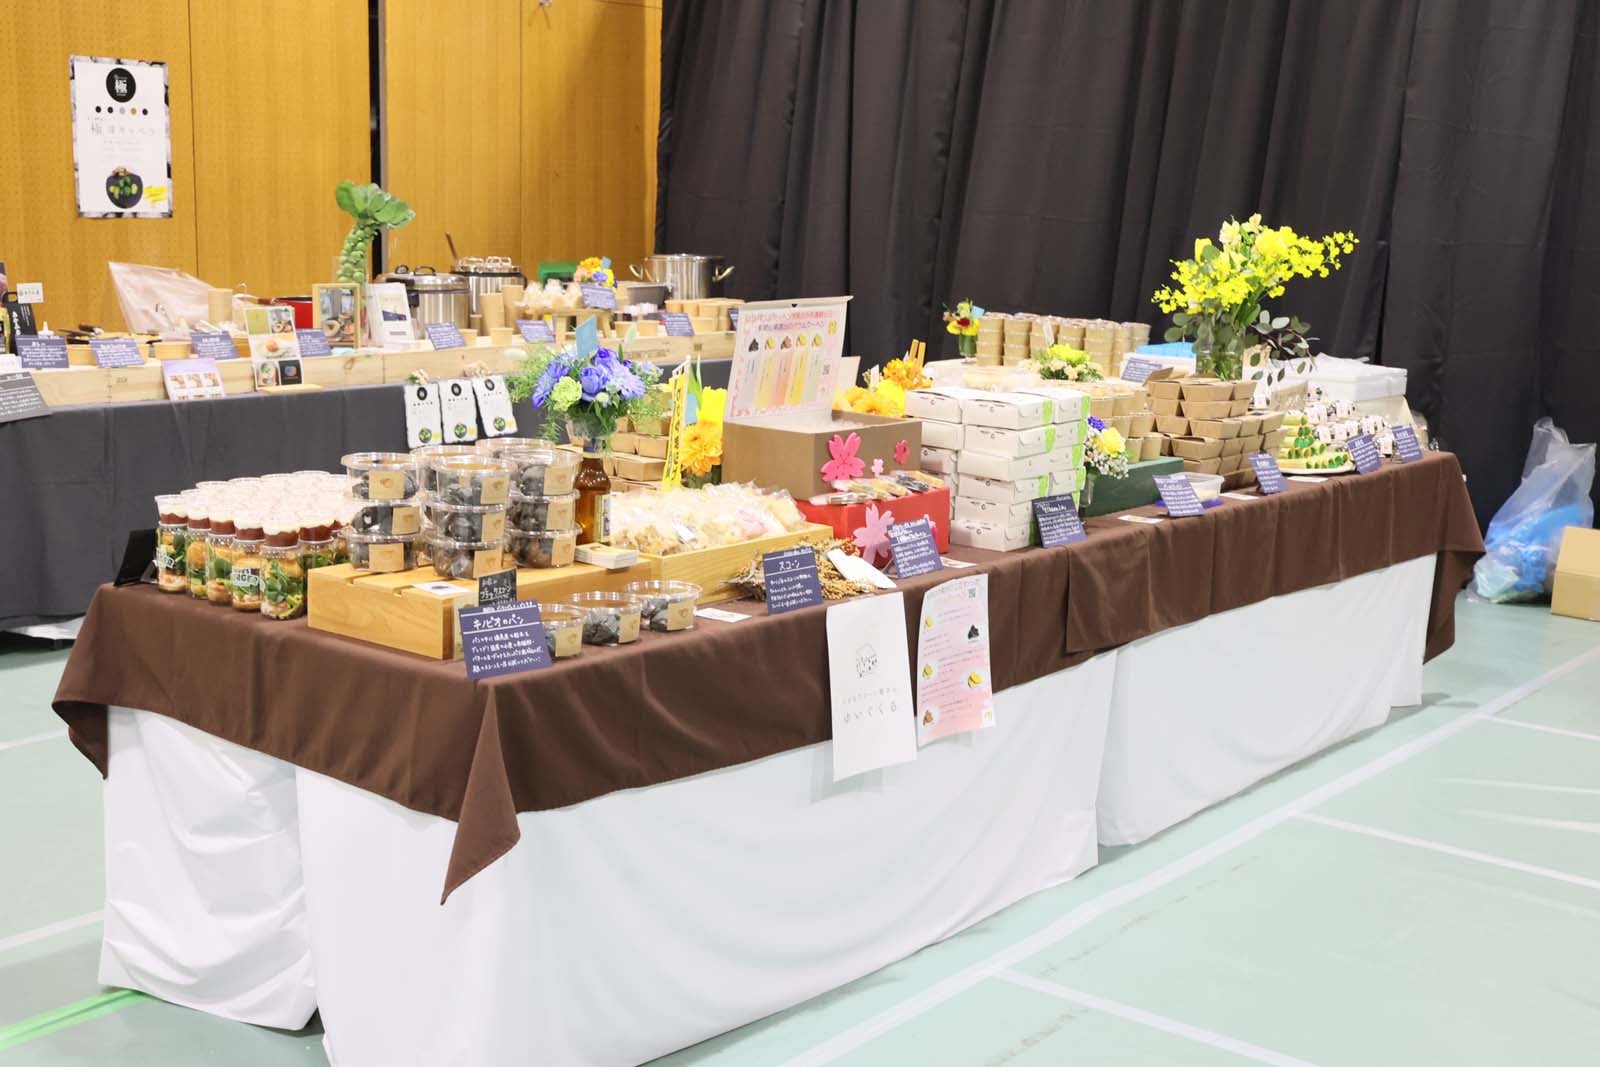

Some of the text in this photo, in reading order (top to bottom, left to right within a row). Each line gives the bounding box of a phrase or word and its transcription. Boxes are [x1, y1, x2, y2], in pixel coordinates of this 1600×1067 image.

[779, 560, 800, 571] スコーン
[473, 613, 524, 630] キノピオのパン
